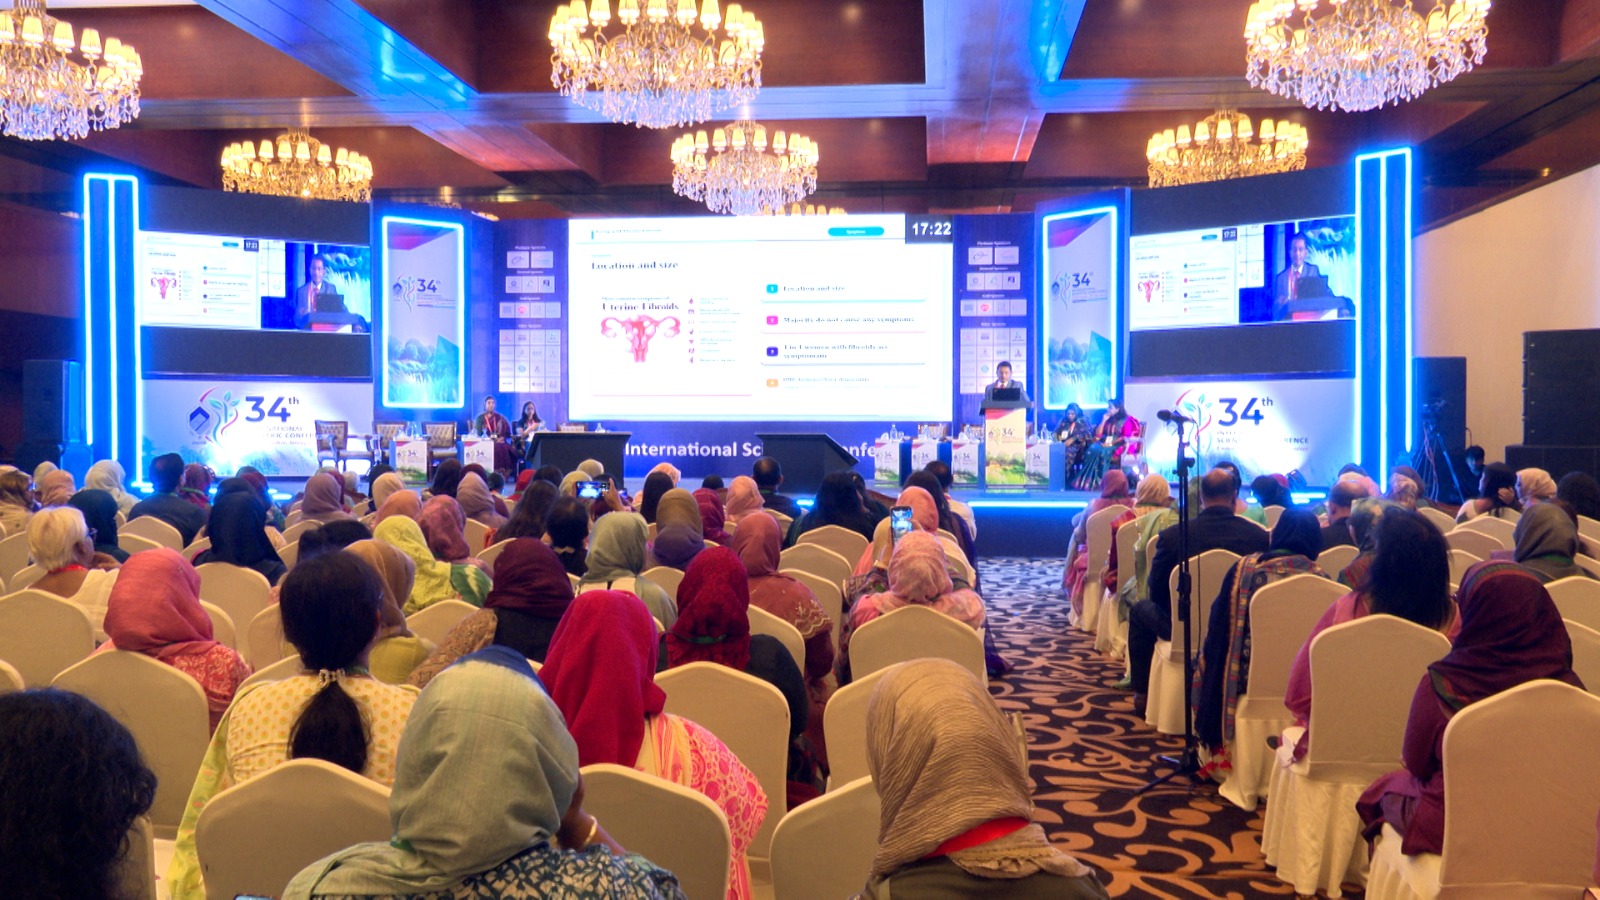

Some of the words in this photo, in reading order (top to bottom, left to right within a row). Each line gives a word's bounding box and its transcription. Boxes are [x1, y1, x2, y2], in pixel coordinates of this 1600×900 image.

[912, 221, 952, 236] 17:22
[591, 262, 635, 270] Location
[637, 261, 656, 269] and
[659, 261, 679, 269] size
[245, 395, 300, 423] 34th
[1217, 396, 1274, 426] 34th
[625, 441, 738, 457] International
